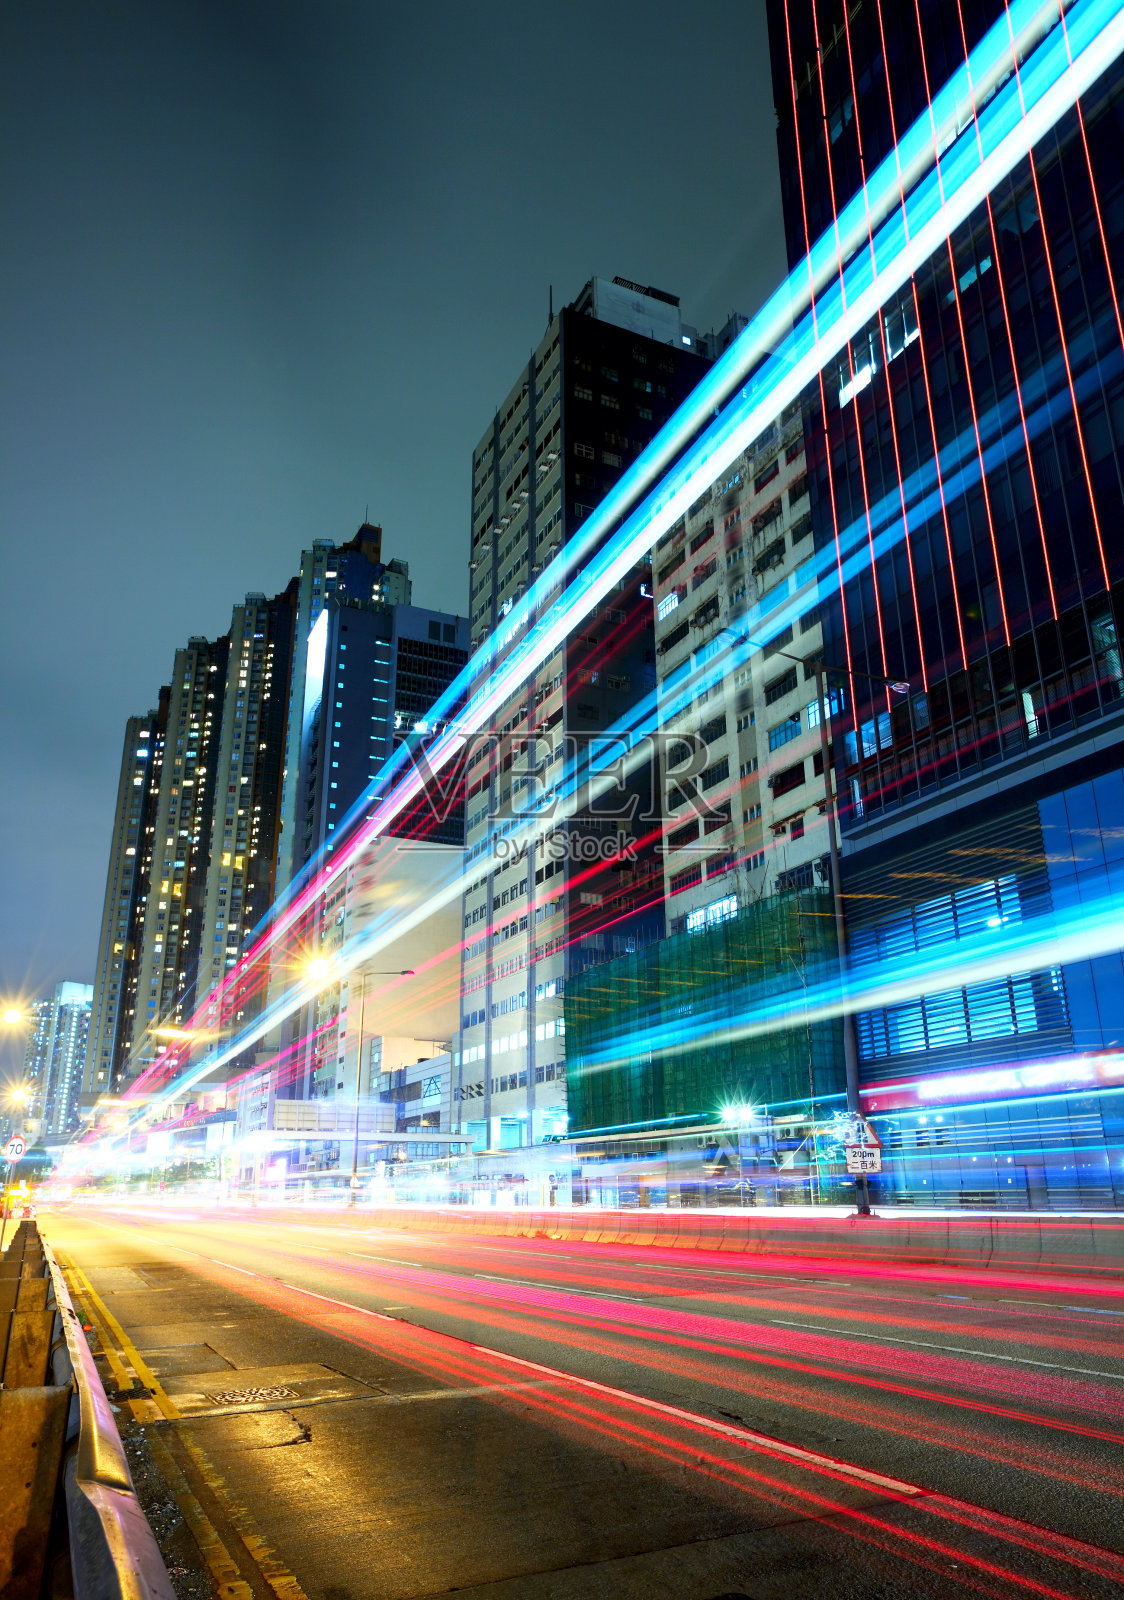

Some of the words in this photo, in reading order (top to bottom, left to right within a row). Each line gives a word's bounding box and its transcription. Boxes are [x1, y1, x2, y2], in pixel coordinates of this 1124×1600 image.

[9, 1143, 23, 1155] 70
[851, 1160, 877, 1169] 二百米
